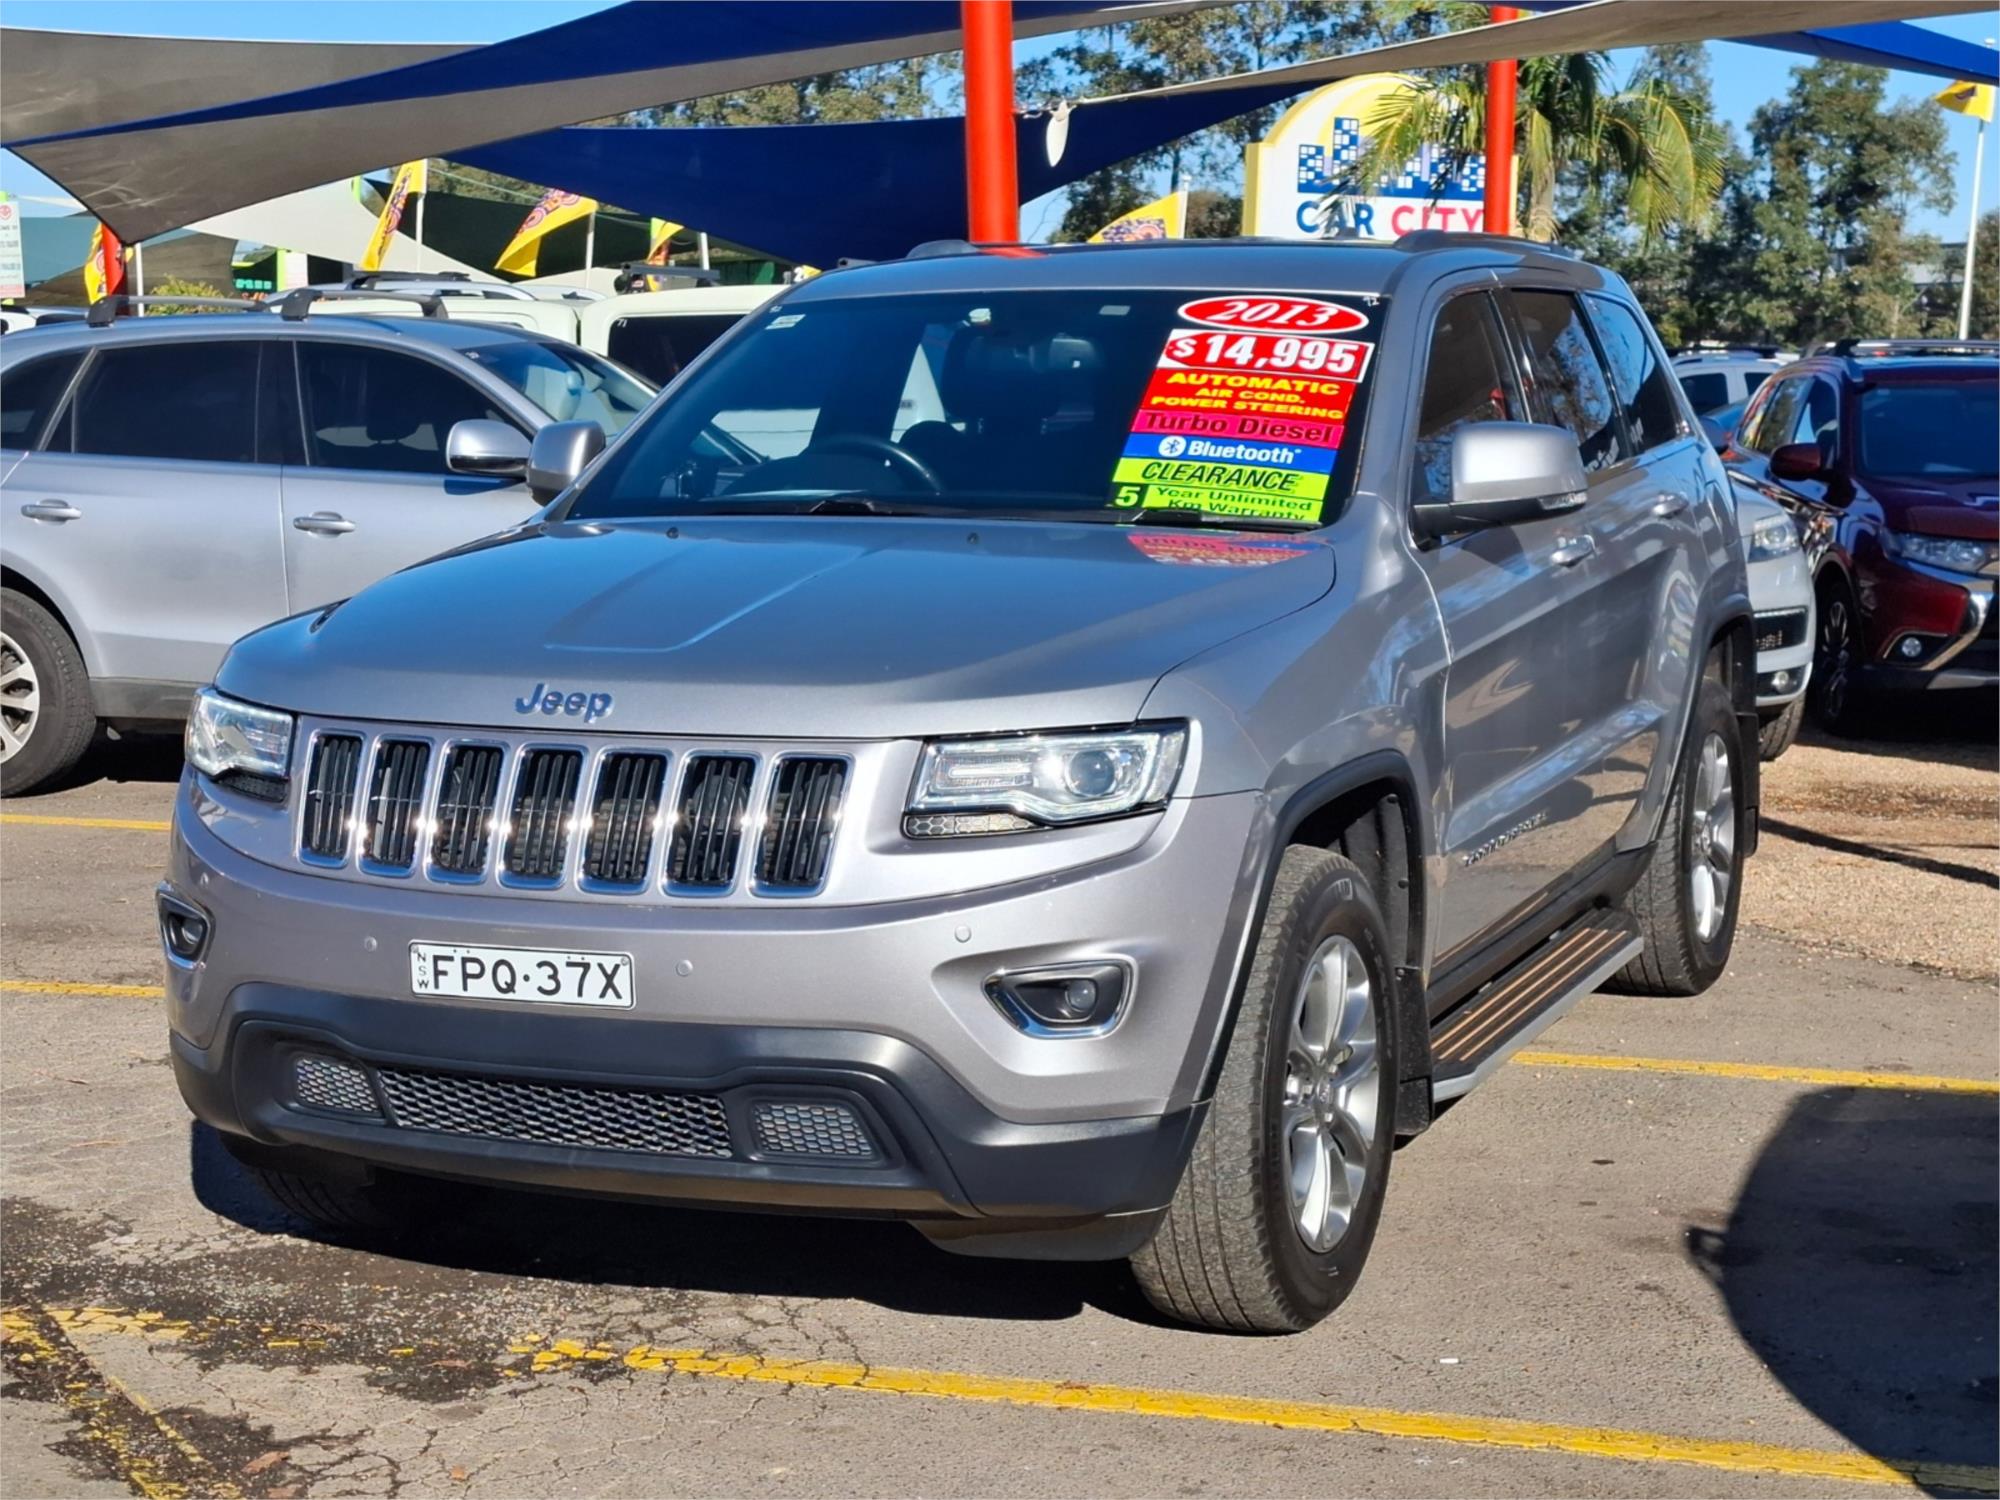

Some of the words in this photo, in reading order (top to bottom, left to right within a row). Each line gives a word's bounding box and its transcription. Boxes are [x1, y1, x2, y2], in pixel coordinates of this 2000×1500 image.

[1296, 200, 1375, 236] CAR
[1391, 205, 1484, 236] CITY
[1206, 299, 1340, 327] 2013
[1171, 334, 1360, 374] $14,995
[1166, 372, 1341, 396] AUTOMATIC
[1195, 387, 1234, 399] AIR
[1239, 390, 1306, 405] COND.
[1151, 396, 1228, 409] POWER
[1233, 400, 1345, 420] STEERING
[1145, 411, 1228, 433] Turbo
[1238, 417, 1333, 443] Diesel
[1188, 440, 1296, 465] Bluetooth
[1141, 461, 1300, 492] CLEARANCE
[1115, 485, 1141, 507] 5
[1156, 486, 1204, 499] Year
[1209, 491, 1313, 511] Unlimited
[1168, 499, 1201, 510] Km
[1209, 502, 1305, 520] Warranty
[515, 682, 613, 724] Jeep
